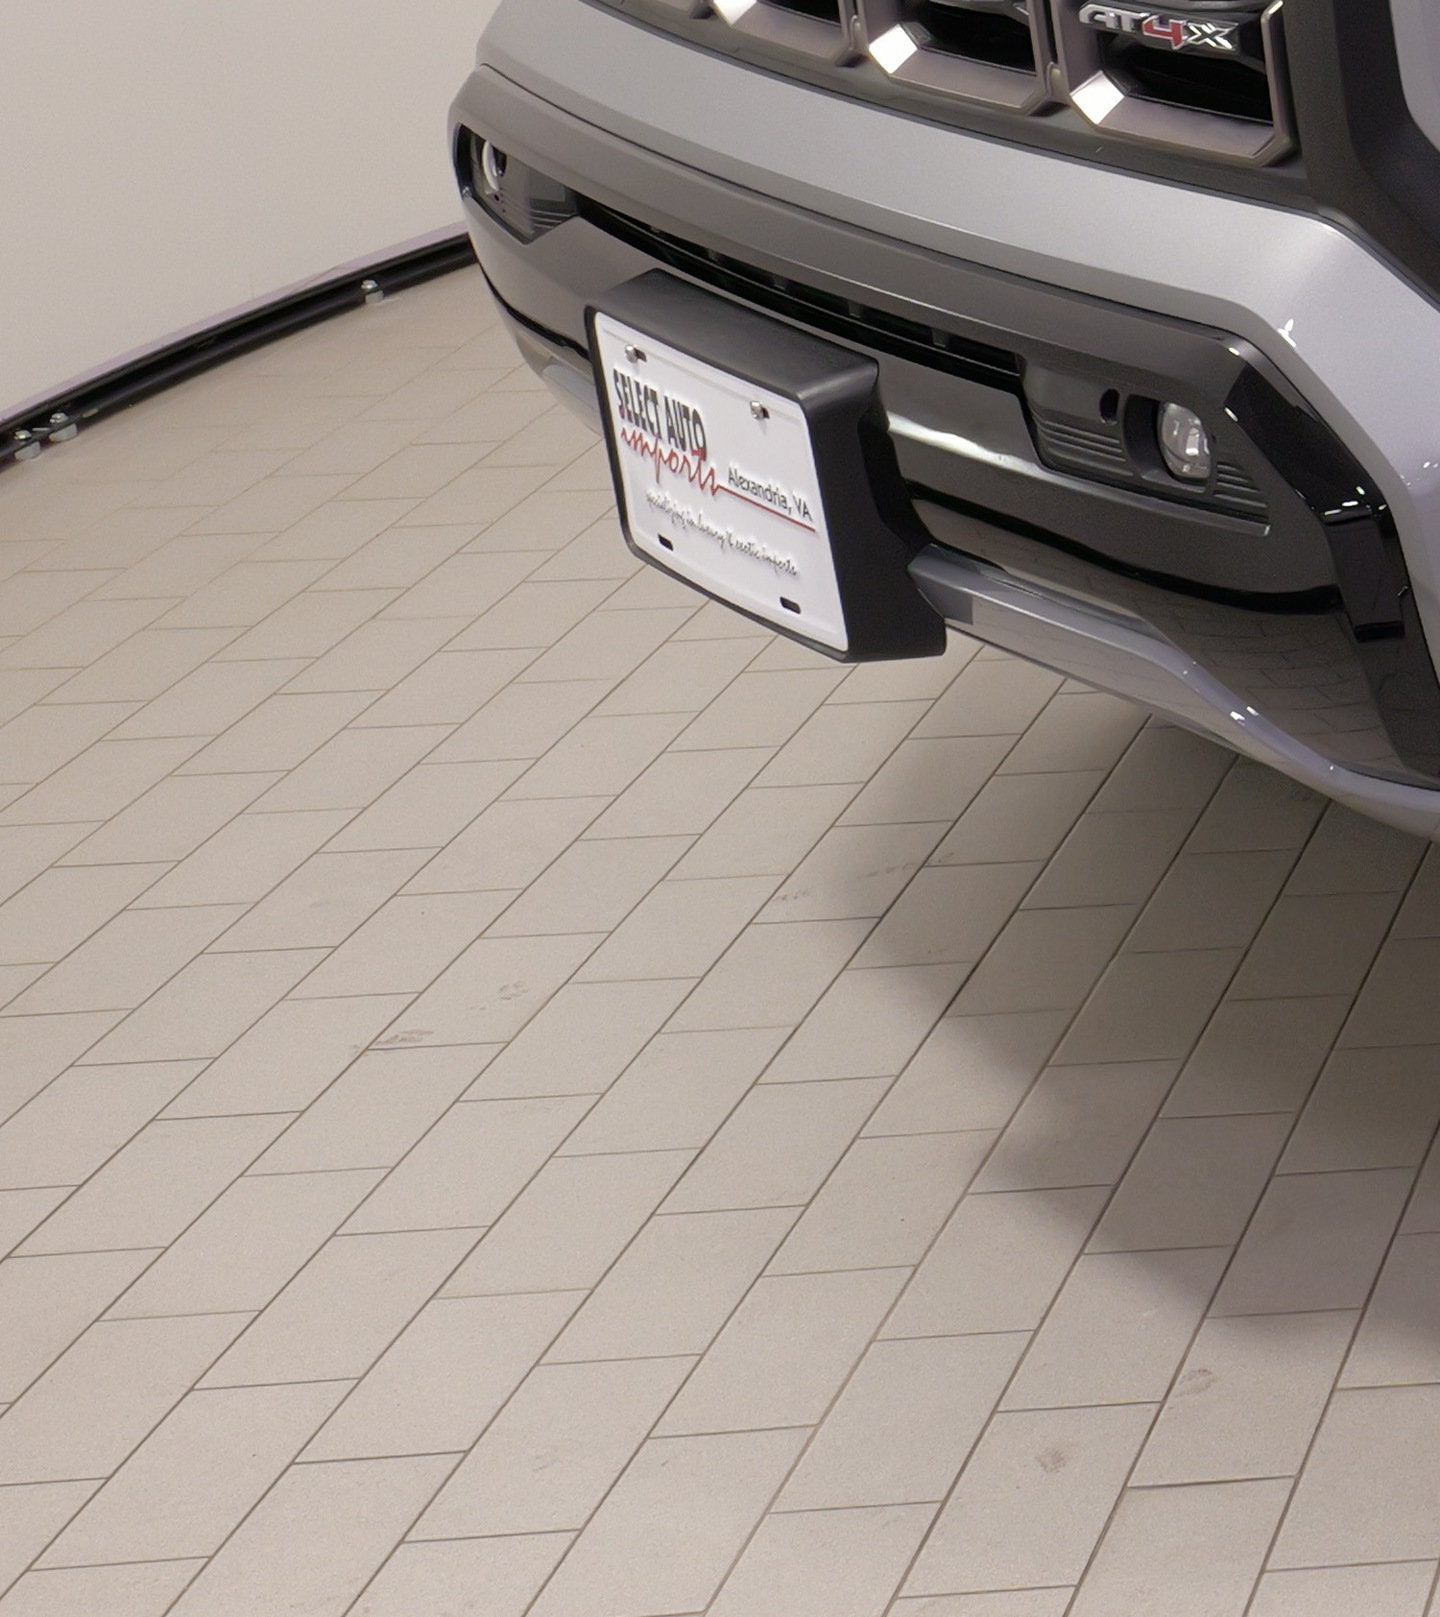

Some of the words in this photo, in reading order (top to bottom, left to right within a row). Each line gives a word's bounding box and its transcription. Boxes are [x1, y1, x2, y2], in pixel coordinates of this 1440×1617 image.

[1079, 3, 1240, 50] AT4X
[613, 367, 662, 441] SELECT
[663, 394, 708, 462] AUTO
[727, 466, 792, 516] Alexandria,
[792, 494, 814, 523] VA
